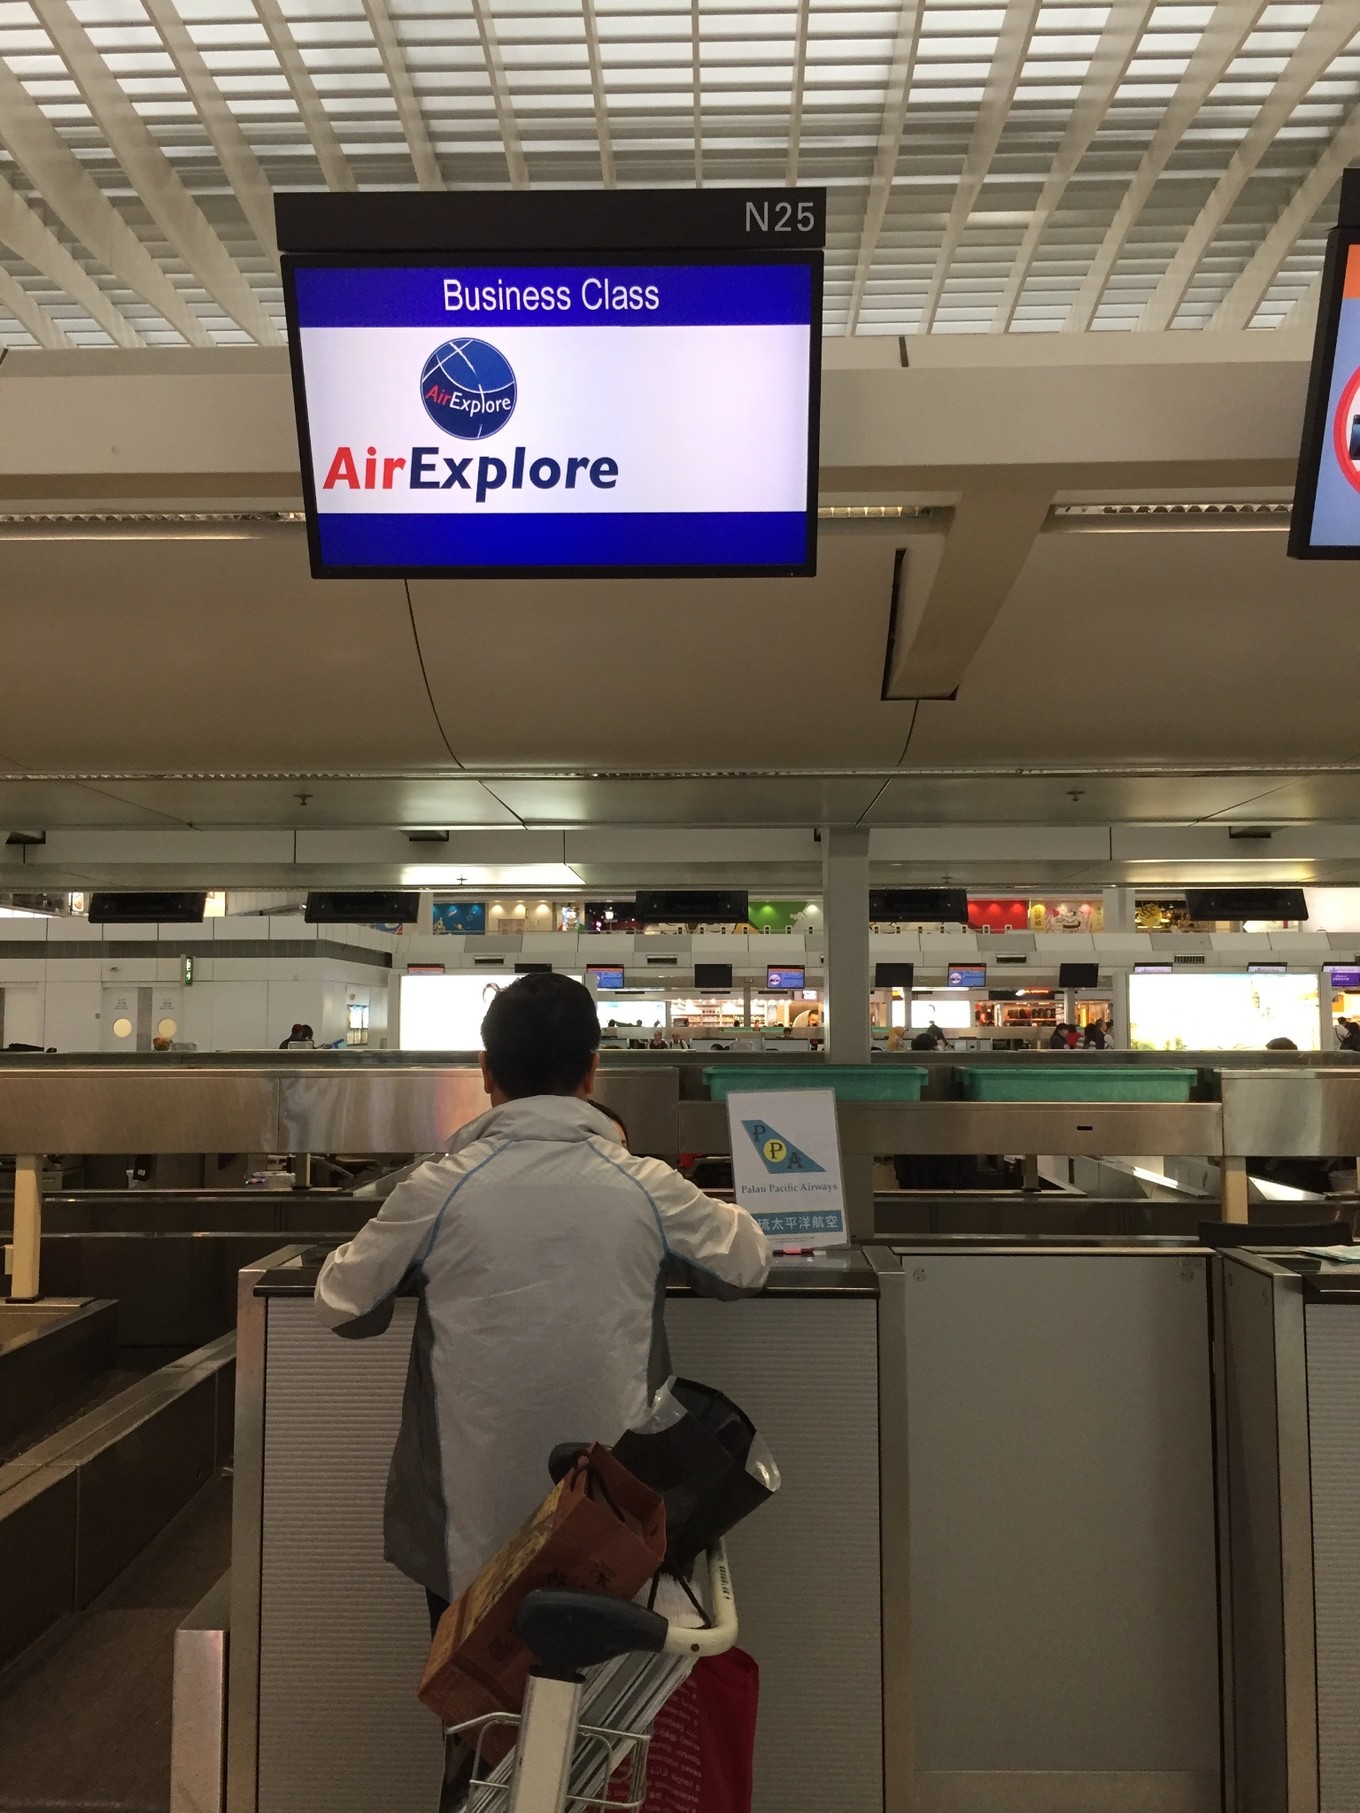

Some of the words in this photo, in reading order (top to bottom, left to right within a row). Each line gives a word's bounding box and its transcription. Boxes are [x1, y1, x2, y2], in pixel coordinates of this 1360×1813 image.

[745, 201, 815, 232] N25
[443, 278, 571, 311] Business
[581, 277, 660, 311] Class
[425, 383, 512, 416] AirExplore
[323, 446, 619, 502] AirExplore
[741, 1185, 767, 1194] Palau
[769, 1183, 798, 1193] Pacific
[799, 1182, 838, 1194] Airways
